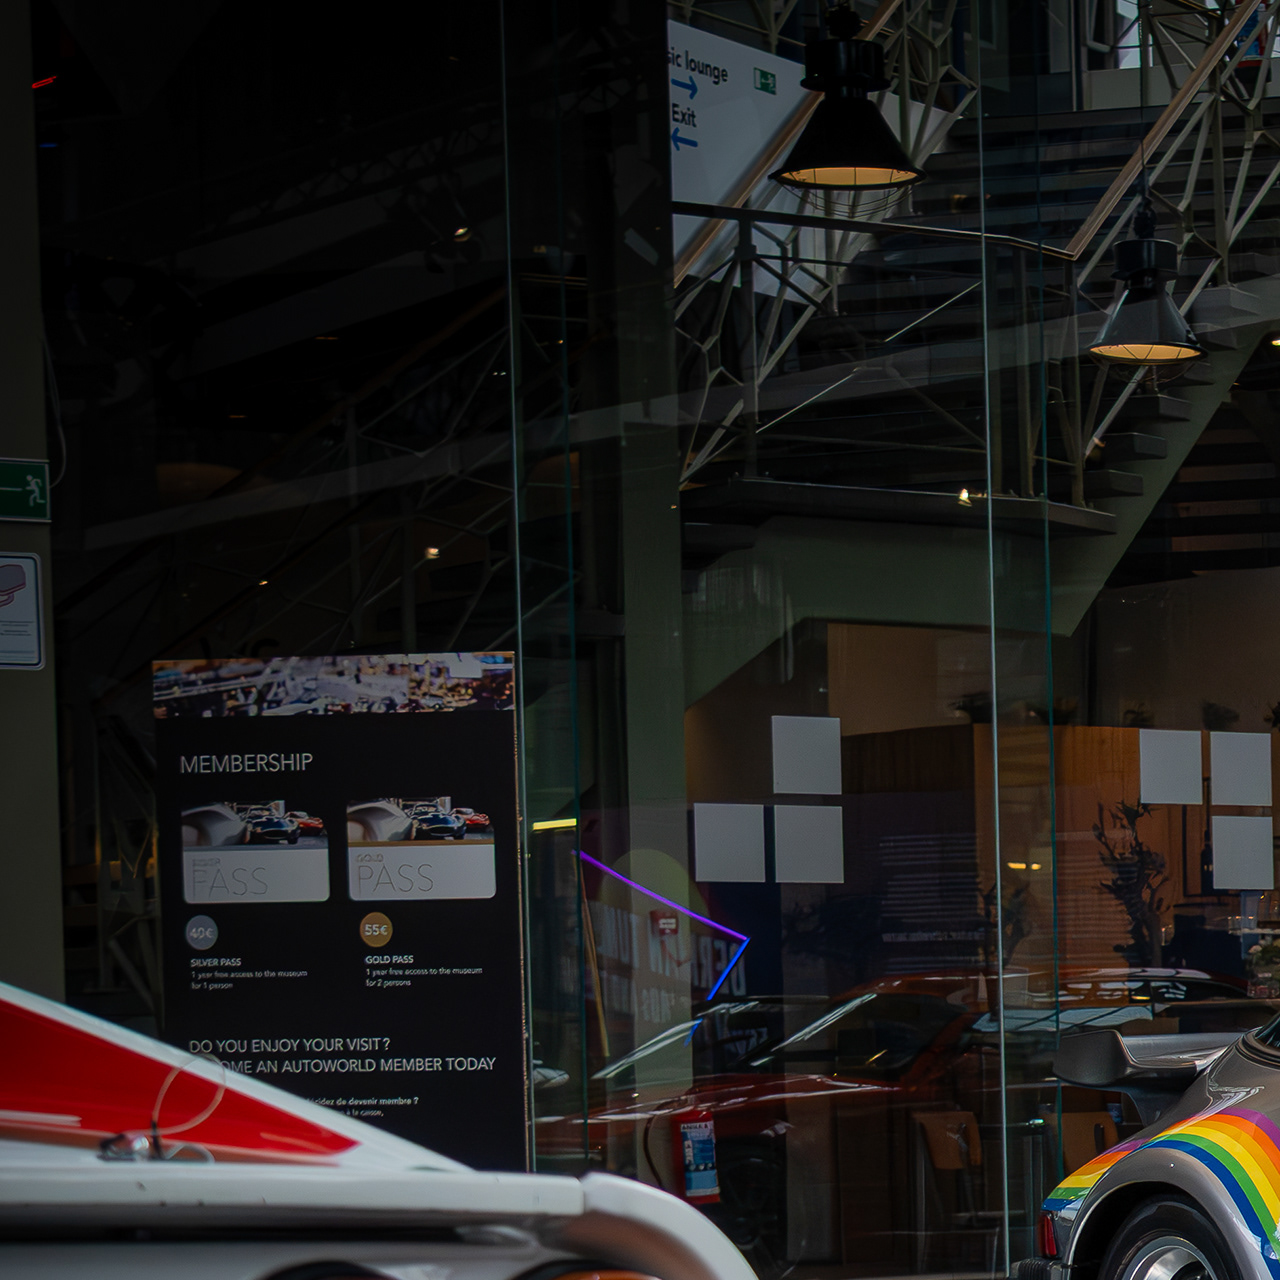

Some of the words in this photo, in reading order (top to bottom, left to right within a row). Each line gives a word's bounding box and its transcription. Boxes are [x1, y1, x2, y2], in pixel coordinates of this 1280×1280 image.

[685, 49, 728, 85] lounge
[671, 102, 697, 127] Exit
[179, 752, 314, 774] MEMBERSHIP
[357, 863, 434, 893] PASS
[364, 923, 388, 936] 55€
[190, 958, 219, 967] SILVER
[220, 957, 242, 967] PASS
[364, 955, 391, 964] GOLD
[392, 954, 414, 964] PASS
[255, 970, 263, 978] to
[264, 969, 276, 978] the
[429, 967, 437, 975] to
[438, 966, 451, 975] the
[452, 967, 483, 975] museum
[377, 979, 383, 987] 2
[189, 1040, 213, 1054] DO
[215, 1039, 248, 1053] YOU
[251, 1039, 300, 1053] ENJOY
[302, 1038, 344, 1052] YOUR
[256, 1060, 277, 1073] AN
[282, 1058, 377, 1073] AUTOWORLD
[380, 1058, 443, 1072] MEMBER
[445, 1057, 496, 1071] TODAY
